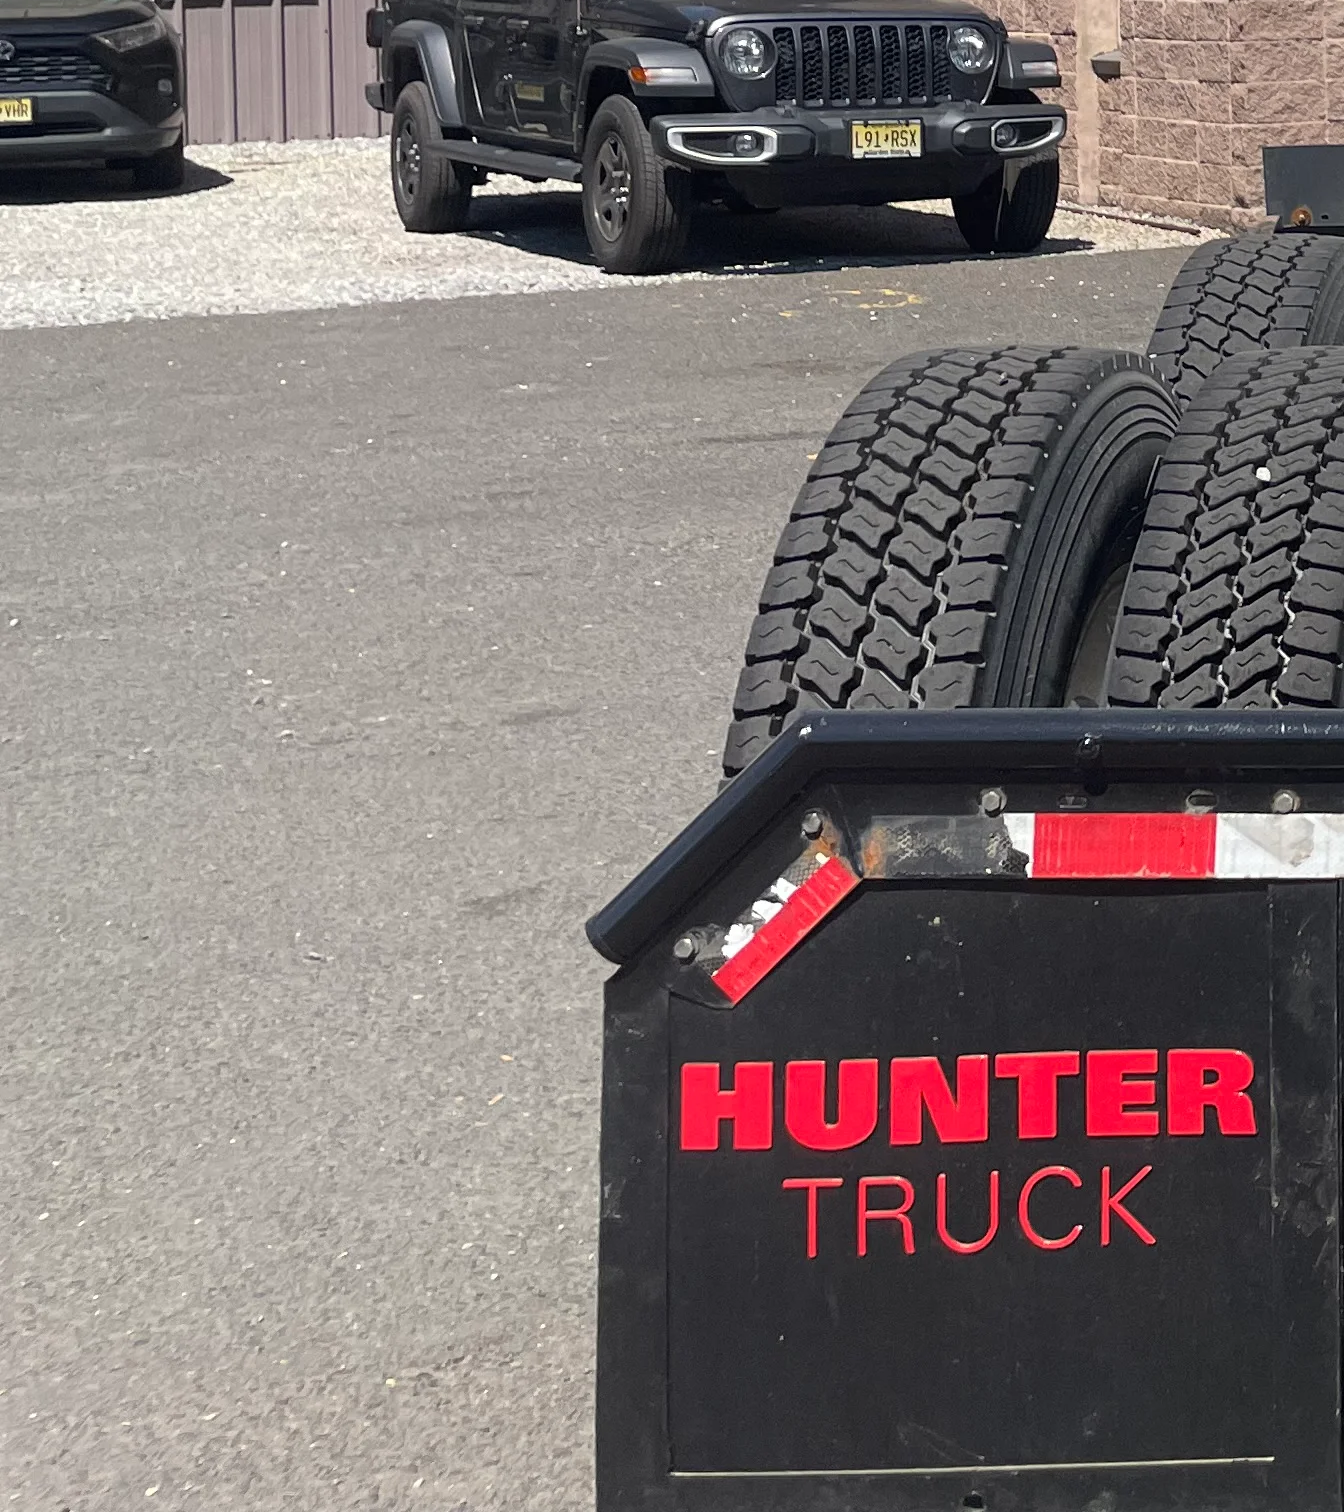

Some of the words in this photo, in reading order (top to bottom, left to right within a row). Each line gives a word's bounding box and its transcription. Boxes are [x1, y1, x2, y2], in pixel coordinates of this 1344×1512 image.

[4, 103, 29, 118] VHR
[855, 130, 881, 149] L91
[891, 129, 917, 148] RSX
[680, 1048, 1257, 1152] HUNTER
[782, 1165, 1157, 1259] TRUCK
